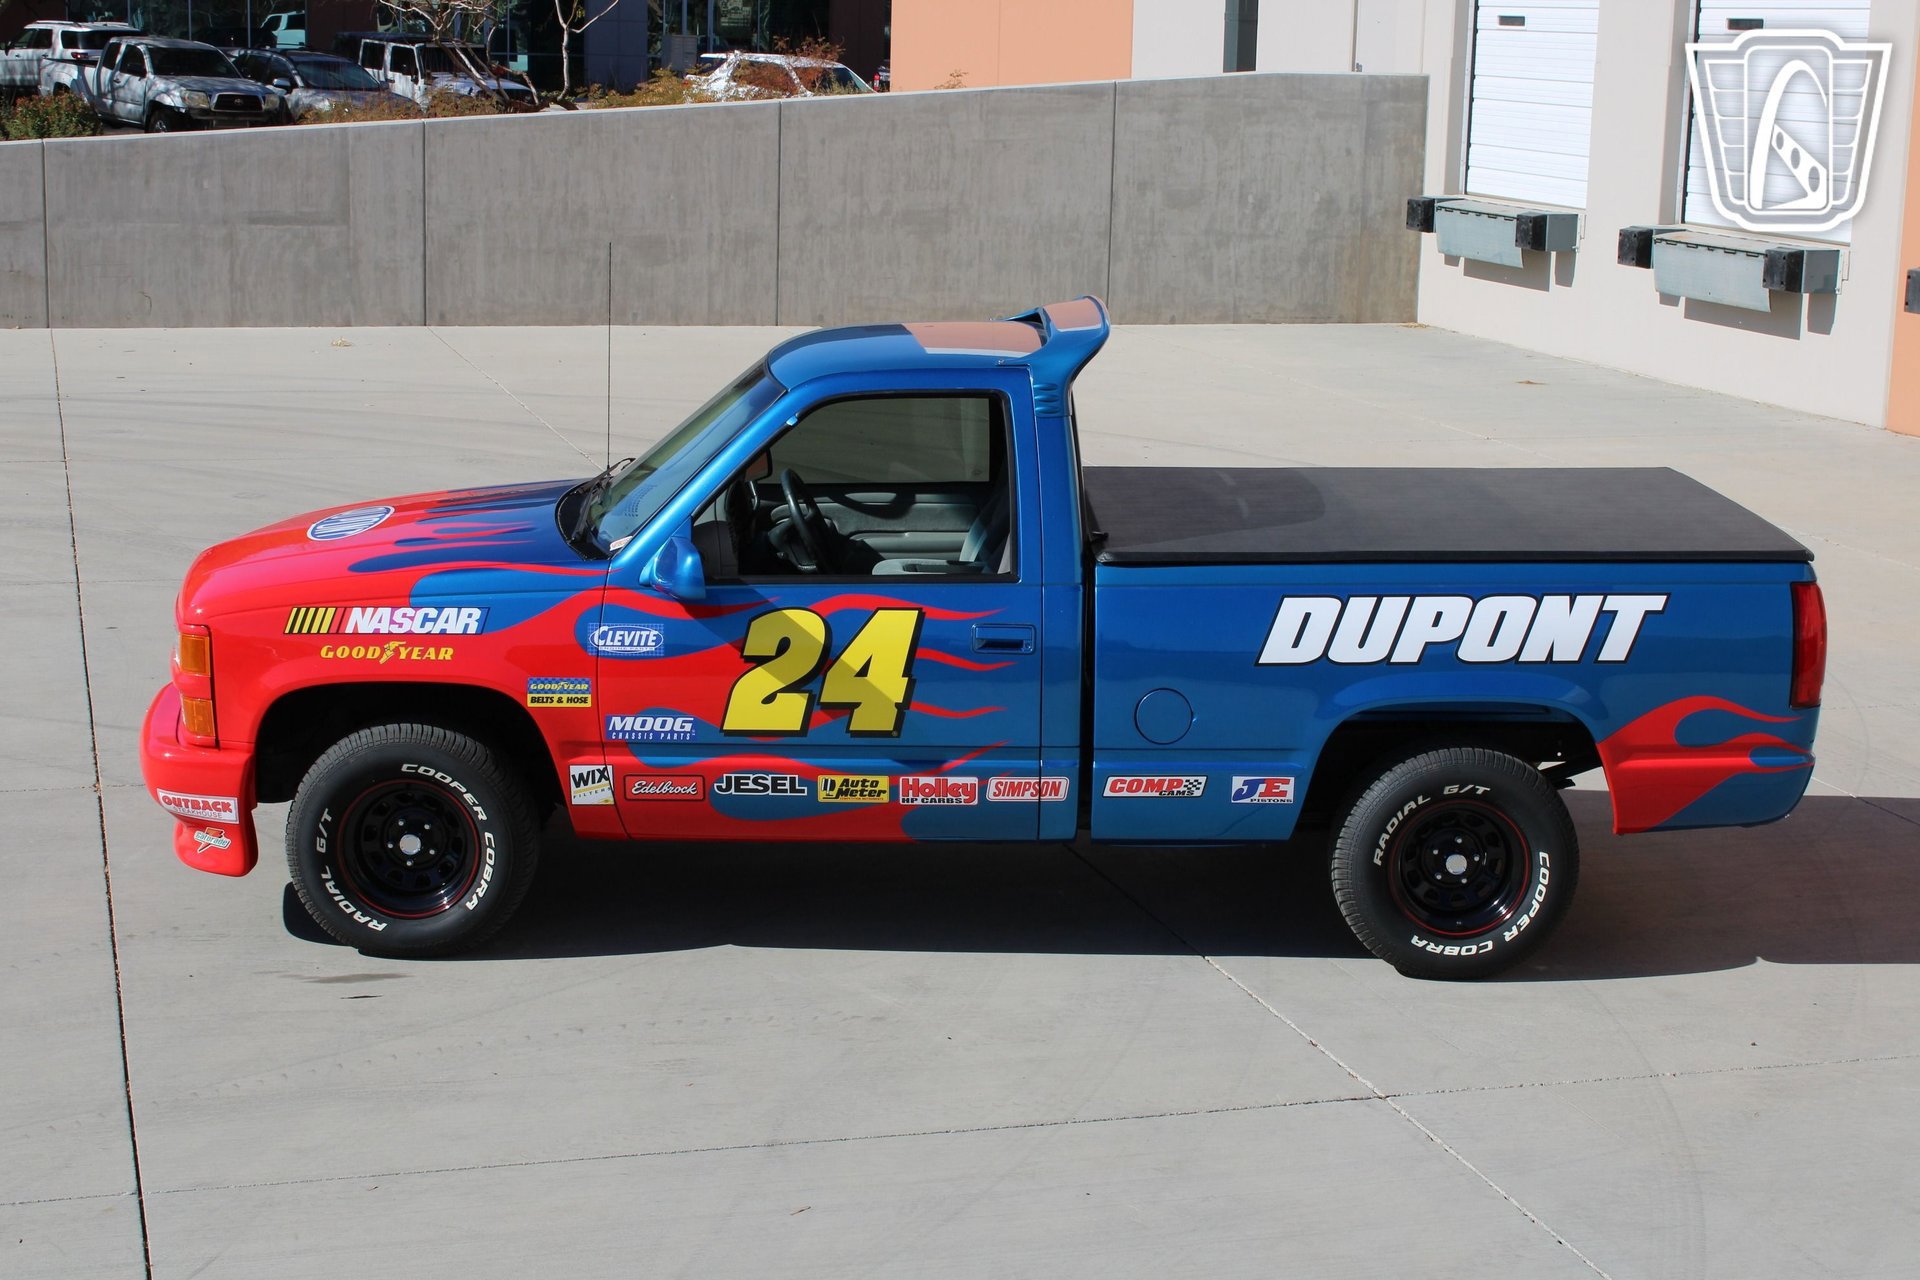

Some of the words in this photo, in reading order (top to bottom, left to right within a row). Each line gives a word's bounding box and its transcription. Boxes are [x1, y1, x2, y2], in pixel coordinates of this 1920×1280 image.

[344, 607, 482, 634] NASCAR
[1255, 593, 1670, 666] DUPONT
[594, 626, 658, 646] CLEVITE
[721, 606, 925, 737] 24
[609, 717, 694, 732] MOOG
[612, 732, 653, 740] CHASSIS
[571, 766, 609, 788] WIX
[631, 780, 697, 795] Edelbrock
[714, 774, 807, 795] JESEL
[839, 778, 879, 788] Auto
[1109, 778, 1184, 793] COMP
[836, 787, 887, 799] Meter
[901, 778, 976, 804] Holley
[992, 780, 1062, 797] SIMPSON
[1232, 778, 1291, 801] JE
[162, 795, 233, 813] OUTBACK
[315, 807, 333, 854] G/T
[1373, 794, 1431, 866] RADIAL
[1443, 784, 1491, 795] G/T
[401, 763, 488, 822] COOPER
[464, 831, 496, 911] COBRA
[320, 864, 389, 932] RADIAL
[1503, 851, 1551, 943] COOPER
[1410, 934, 1494, 956] COBRA
